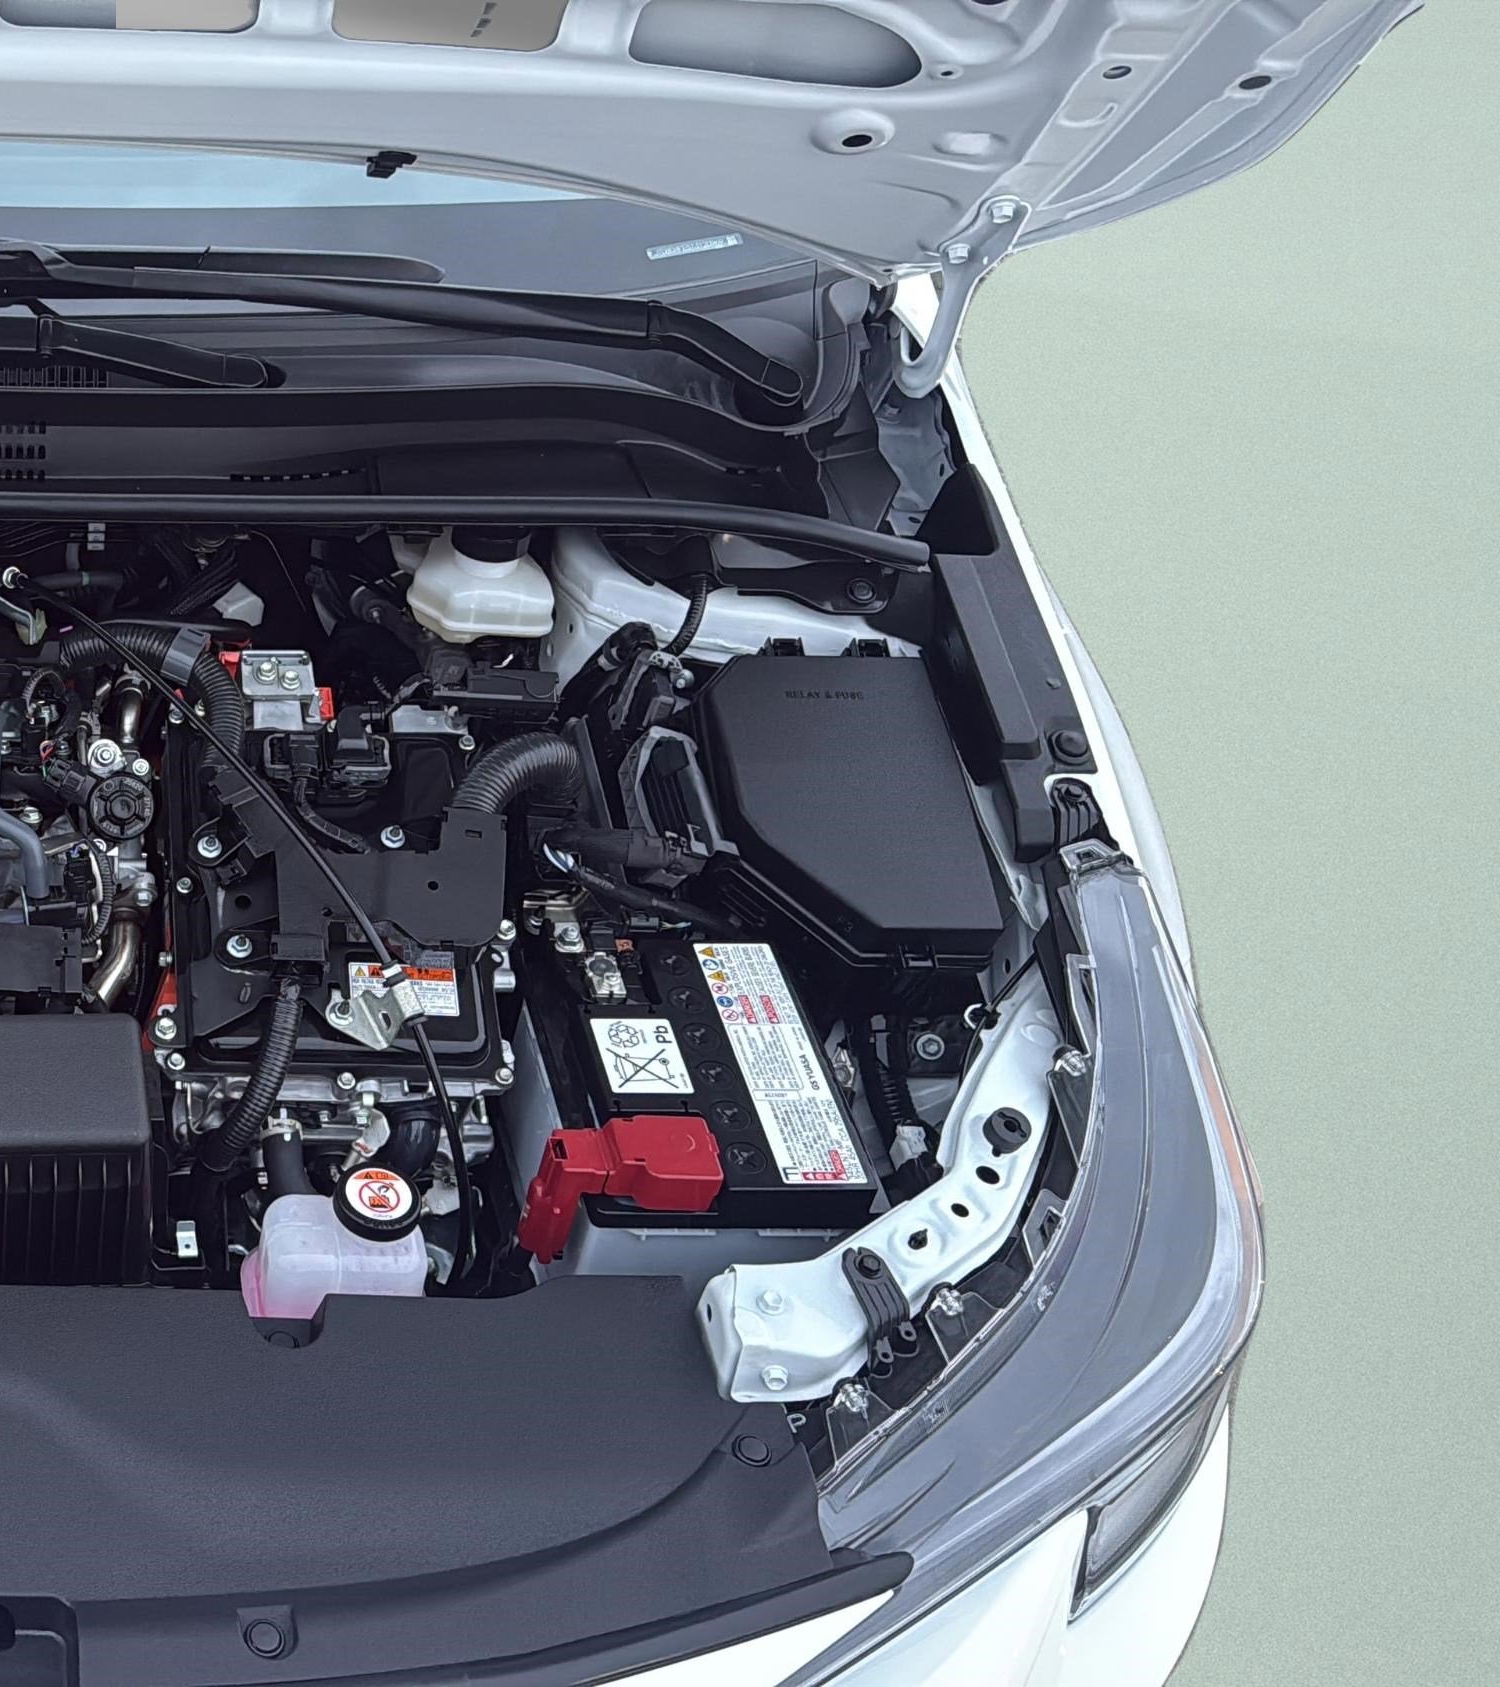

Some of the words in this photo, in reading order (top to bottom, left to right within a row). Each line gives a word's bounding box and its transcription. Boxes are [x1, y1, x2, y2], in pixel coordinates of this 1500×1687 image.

[653, 1025, 673, 1044] Pb
[798, 1054, 816, 1080] YUASA
[809, 1080, 820, 1090] GS
[787, 1413, 807, 1433] P
